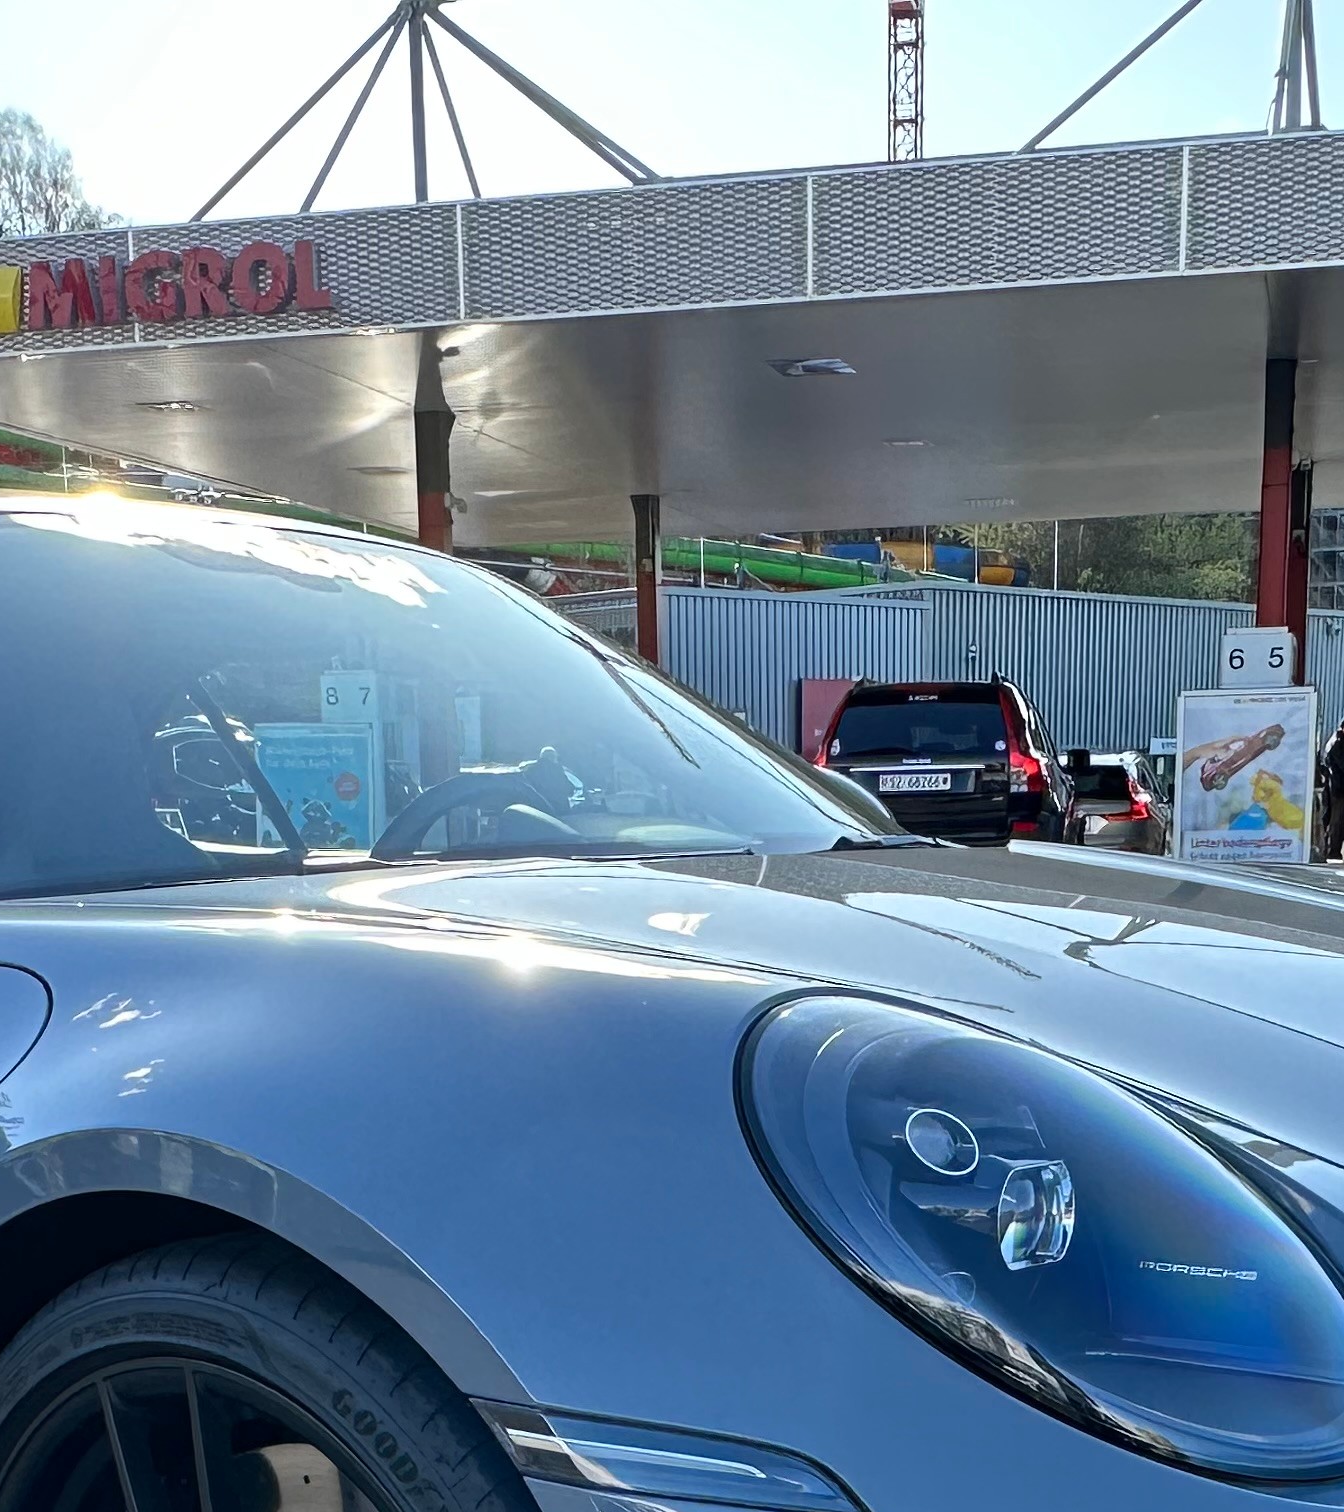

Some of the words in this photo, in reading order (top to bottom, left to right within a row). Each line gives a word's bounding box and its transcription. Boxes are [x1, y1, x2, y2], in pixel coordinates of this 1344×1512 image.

[28, 239, 333, 331] MIGROL
[1228, 648, 1245, 669] 6
[1268, 646, 1285, 668] 5
[326, 686, 339, 705] 8
[359, 687, 371, 705] 7
[1139, 1261, 1258, 1281] PORSCHE
